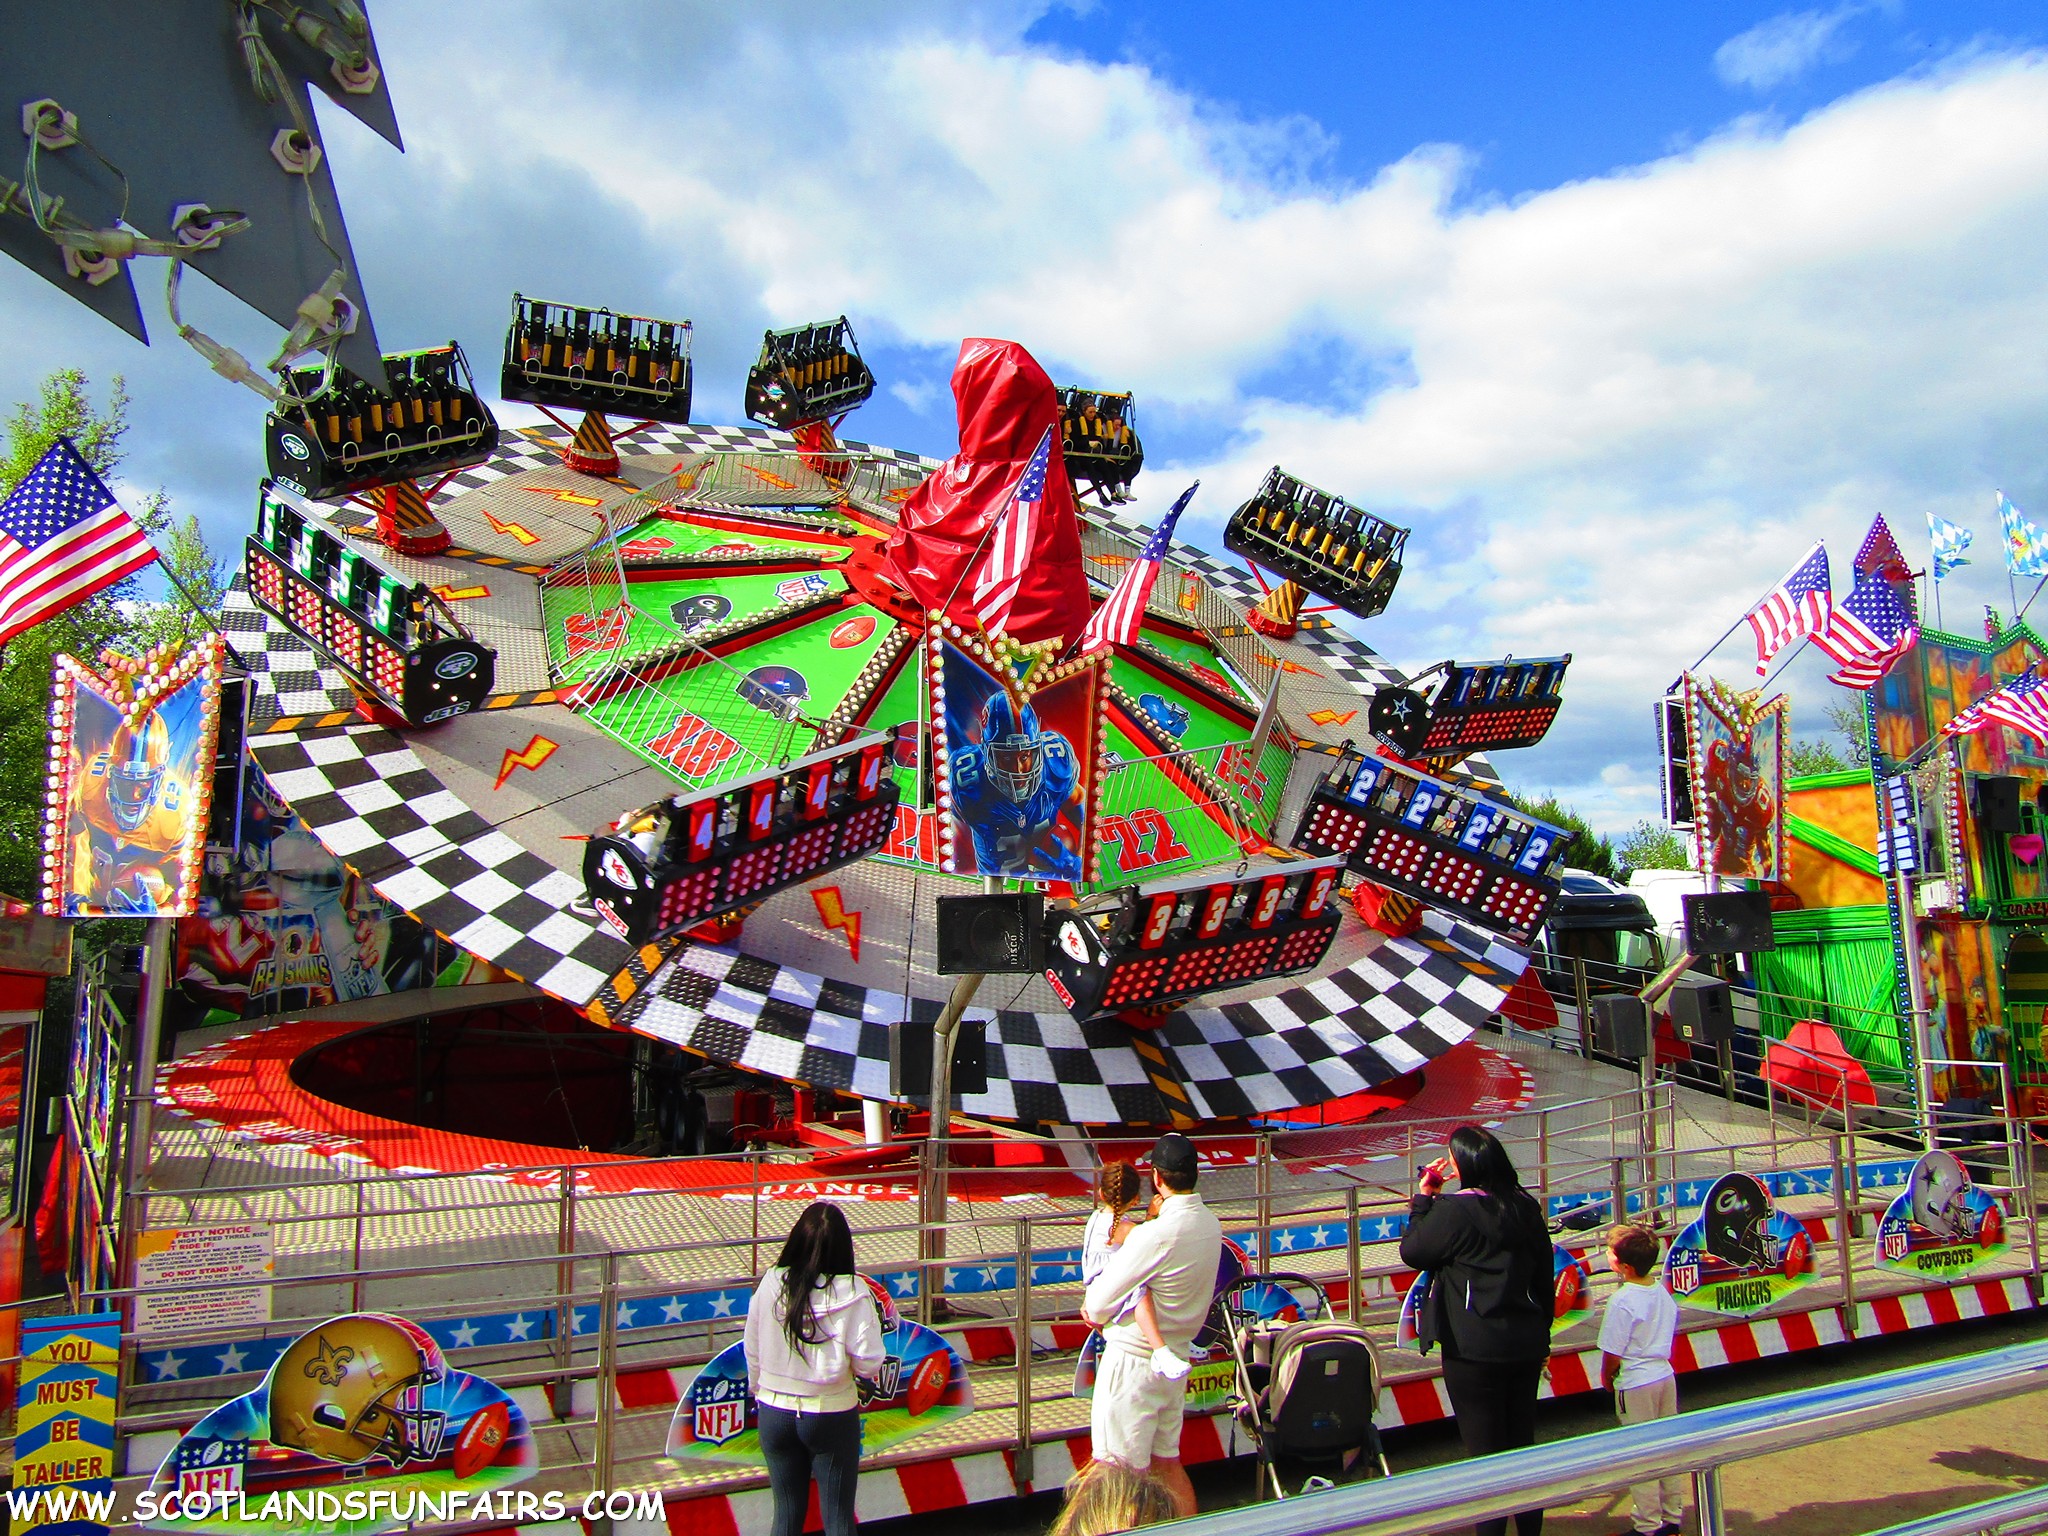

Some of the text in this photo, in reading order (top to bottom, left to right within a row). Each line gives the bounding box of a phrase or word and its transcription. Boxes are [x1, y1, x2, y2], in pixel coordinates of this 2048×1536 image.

[277, 476, 307, 495] JETS
[264, 504, 392, 627] 5 5 5 5
[782, 580, 811, 601] NFL
[424, 701, 471, 723] JETS
[1375, 730, 1407, 758] COWBOYS
[696, 756, 882, 851] 4 4 4 4
[1350, 768, 1550, 870] 2 2 2 2
[596, 900, 628, 936] CHIEFS
[1149, 878, 1331, 941] 3 3 3 3
[1010, 934, 1018, 965] DISCO
[251, 954, 332, 993] RESKINS
[1046, 970, 1075, 1009] CHIEFS
[761, 1182, 914, 1196] DANGE
[176, 1225, 251, 1238] FETY NOTICE
[1885, 1232, 1908, 1257] NFL
[199, 1266, 229, 1274] STAND
[1917, 1247, 1974, 1271] COWBOYS
[1672, 1265, 1699, 1291] NFL
[210, 1300, 251, 1308] VALUABLES
[1715, 1280, 1773, 1311] PACKERS
[49, 1341, 92, 1362] YOU
[37, 1378, 99, 1405] MUST
[1185, 1374, 1235, 1395] KING
[51, 1420, 79, 1442] BE
[697, 1402, 743, 1439] NFL
[22, 1456, 103, 1488] TALLER
[181, 1467, 241, 1506] NFL
